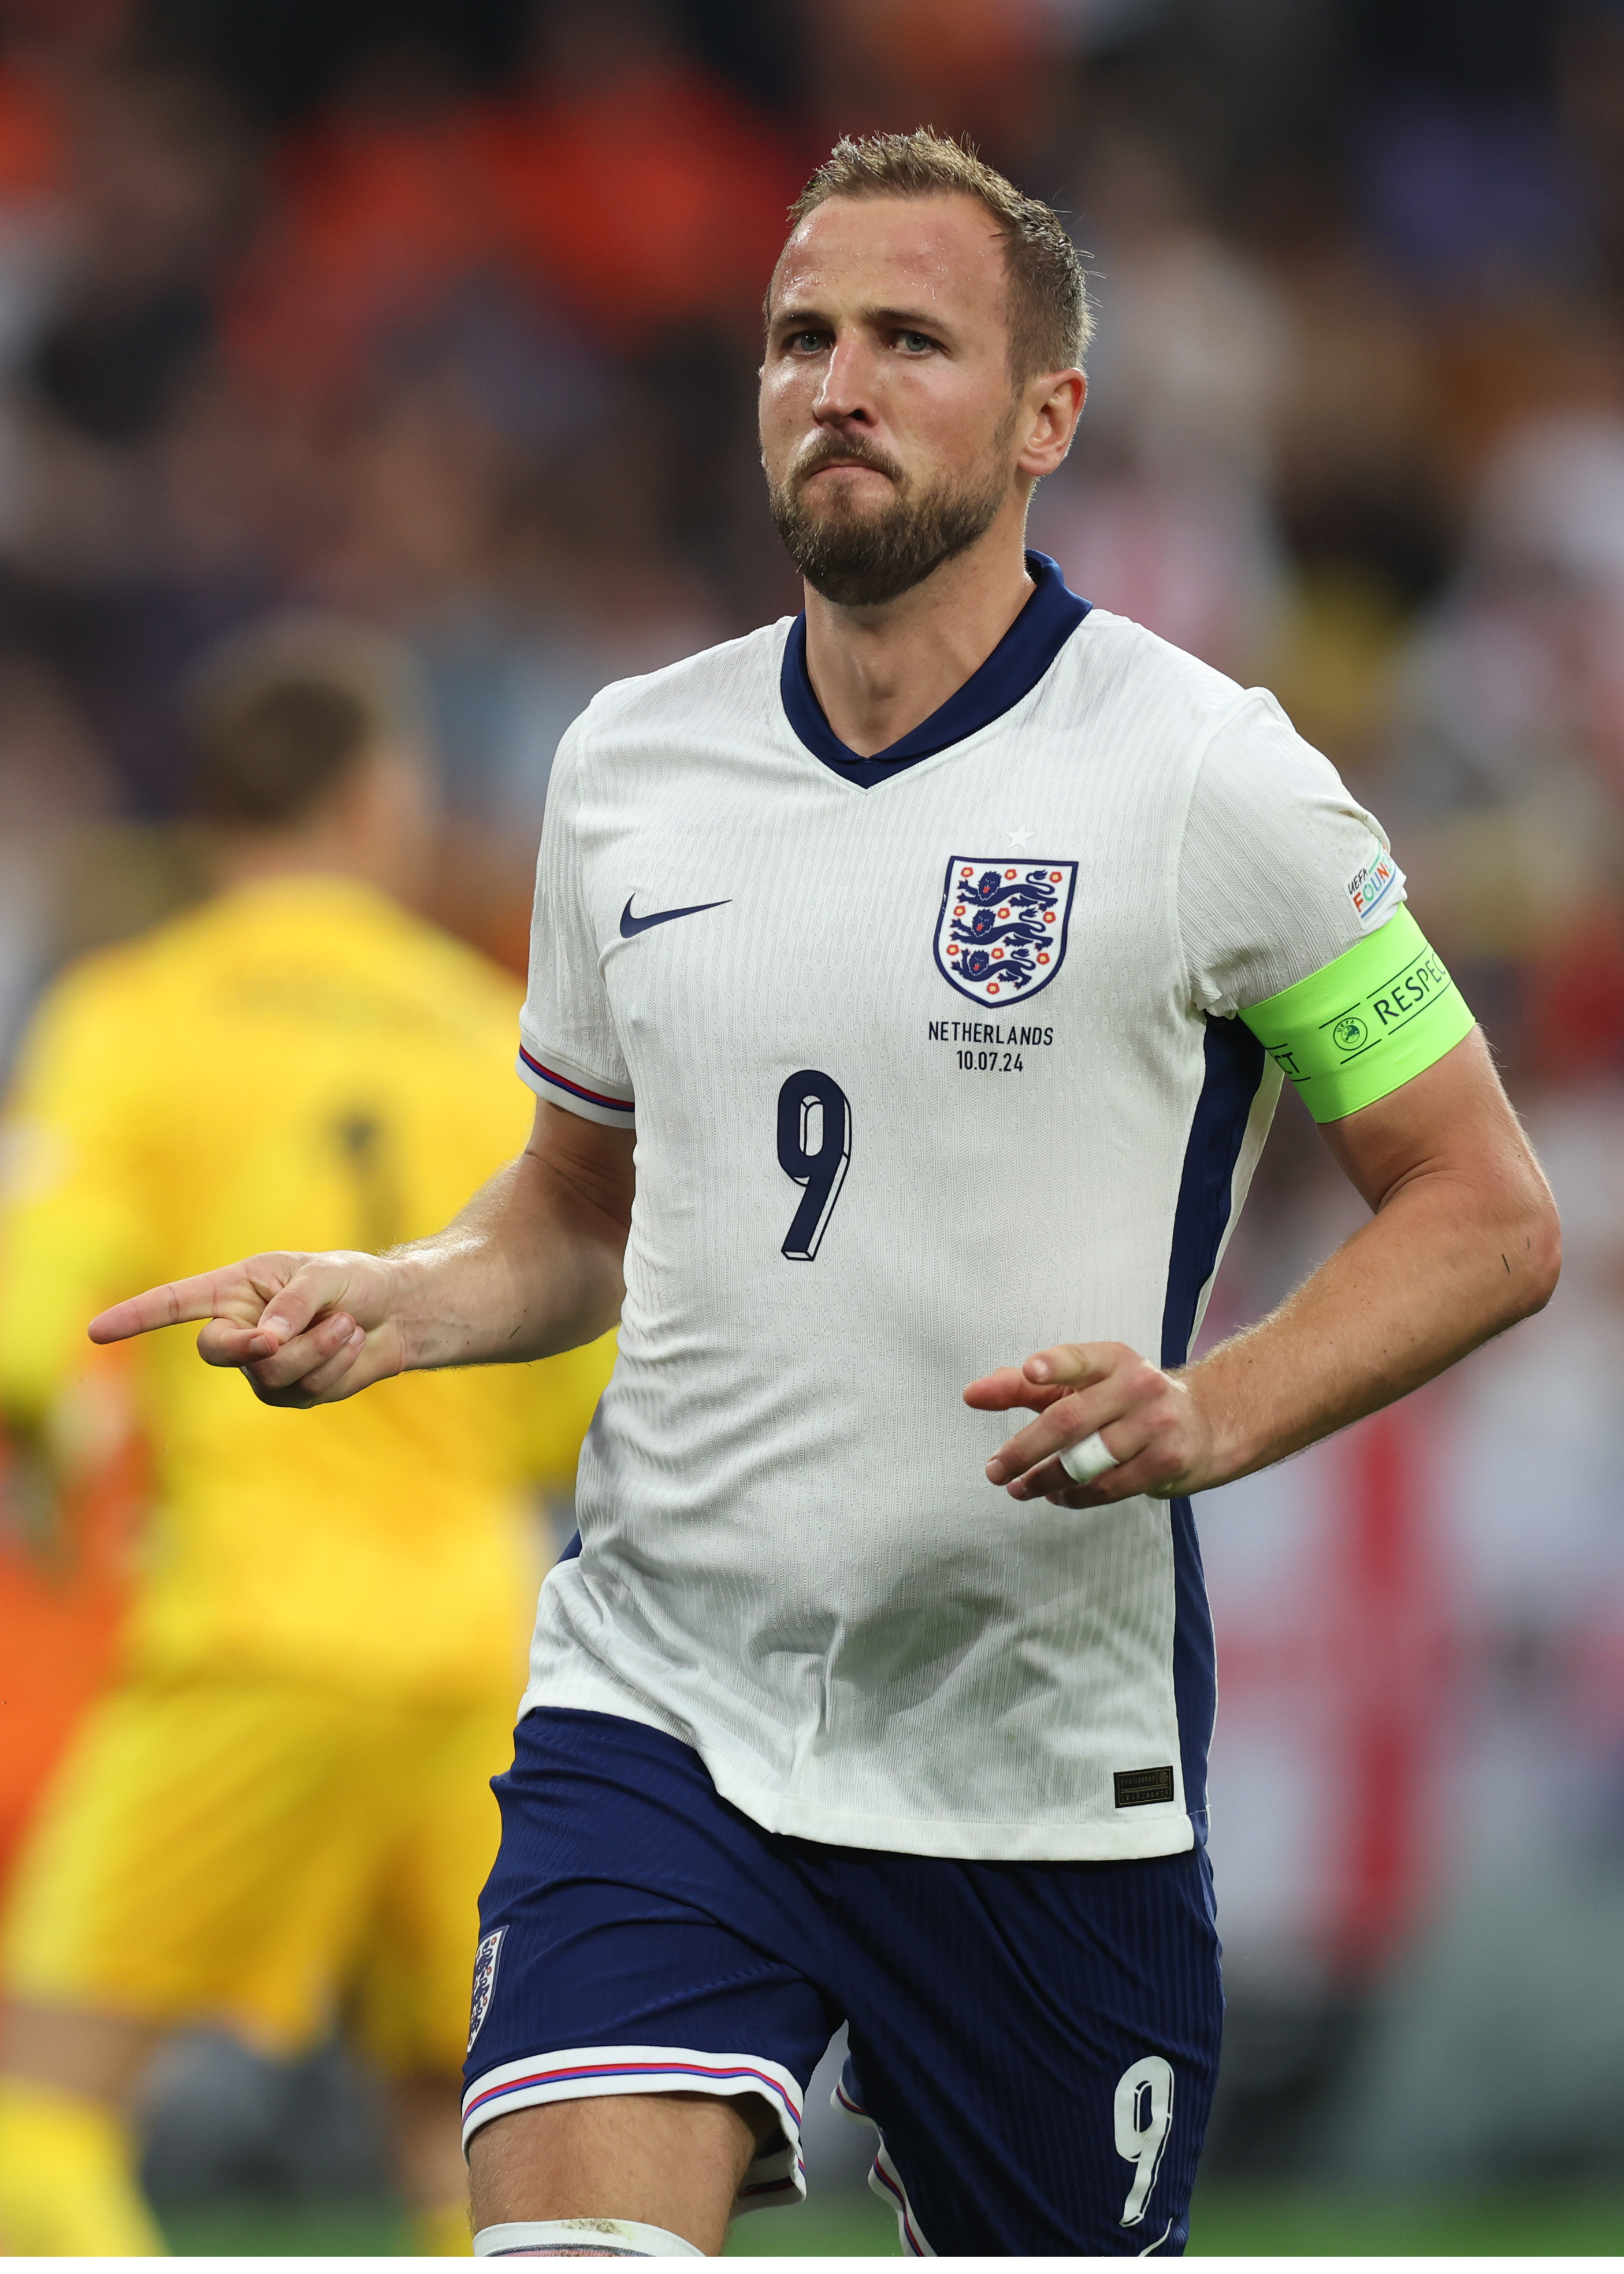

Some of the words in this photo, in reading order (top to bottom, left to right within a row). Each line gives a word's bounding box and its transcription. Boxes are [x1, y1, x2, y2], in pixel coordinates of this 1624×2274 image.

[1348, 868, 1368, 895] UEFA
[1353, 854, 1392, 912] FOUND
[928, 1021, 1054, 1046] NETHERLANDS
[957, 1050, 1023, 1072] 10.07.24
[777, 1069, 852, 1261] 9
[1114, 2056, 1174, 2227] 9
